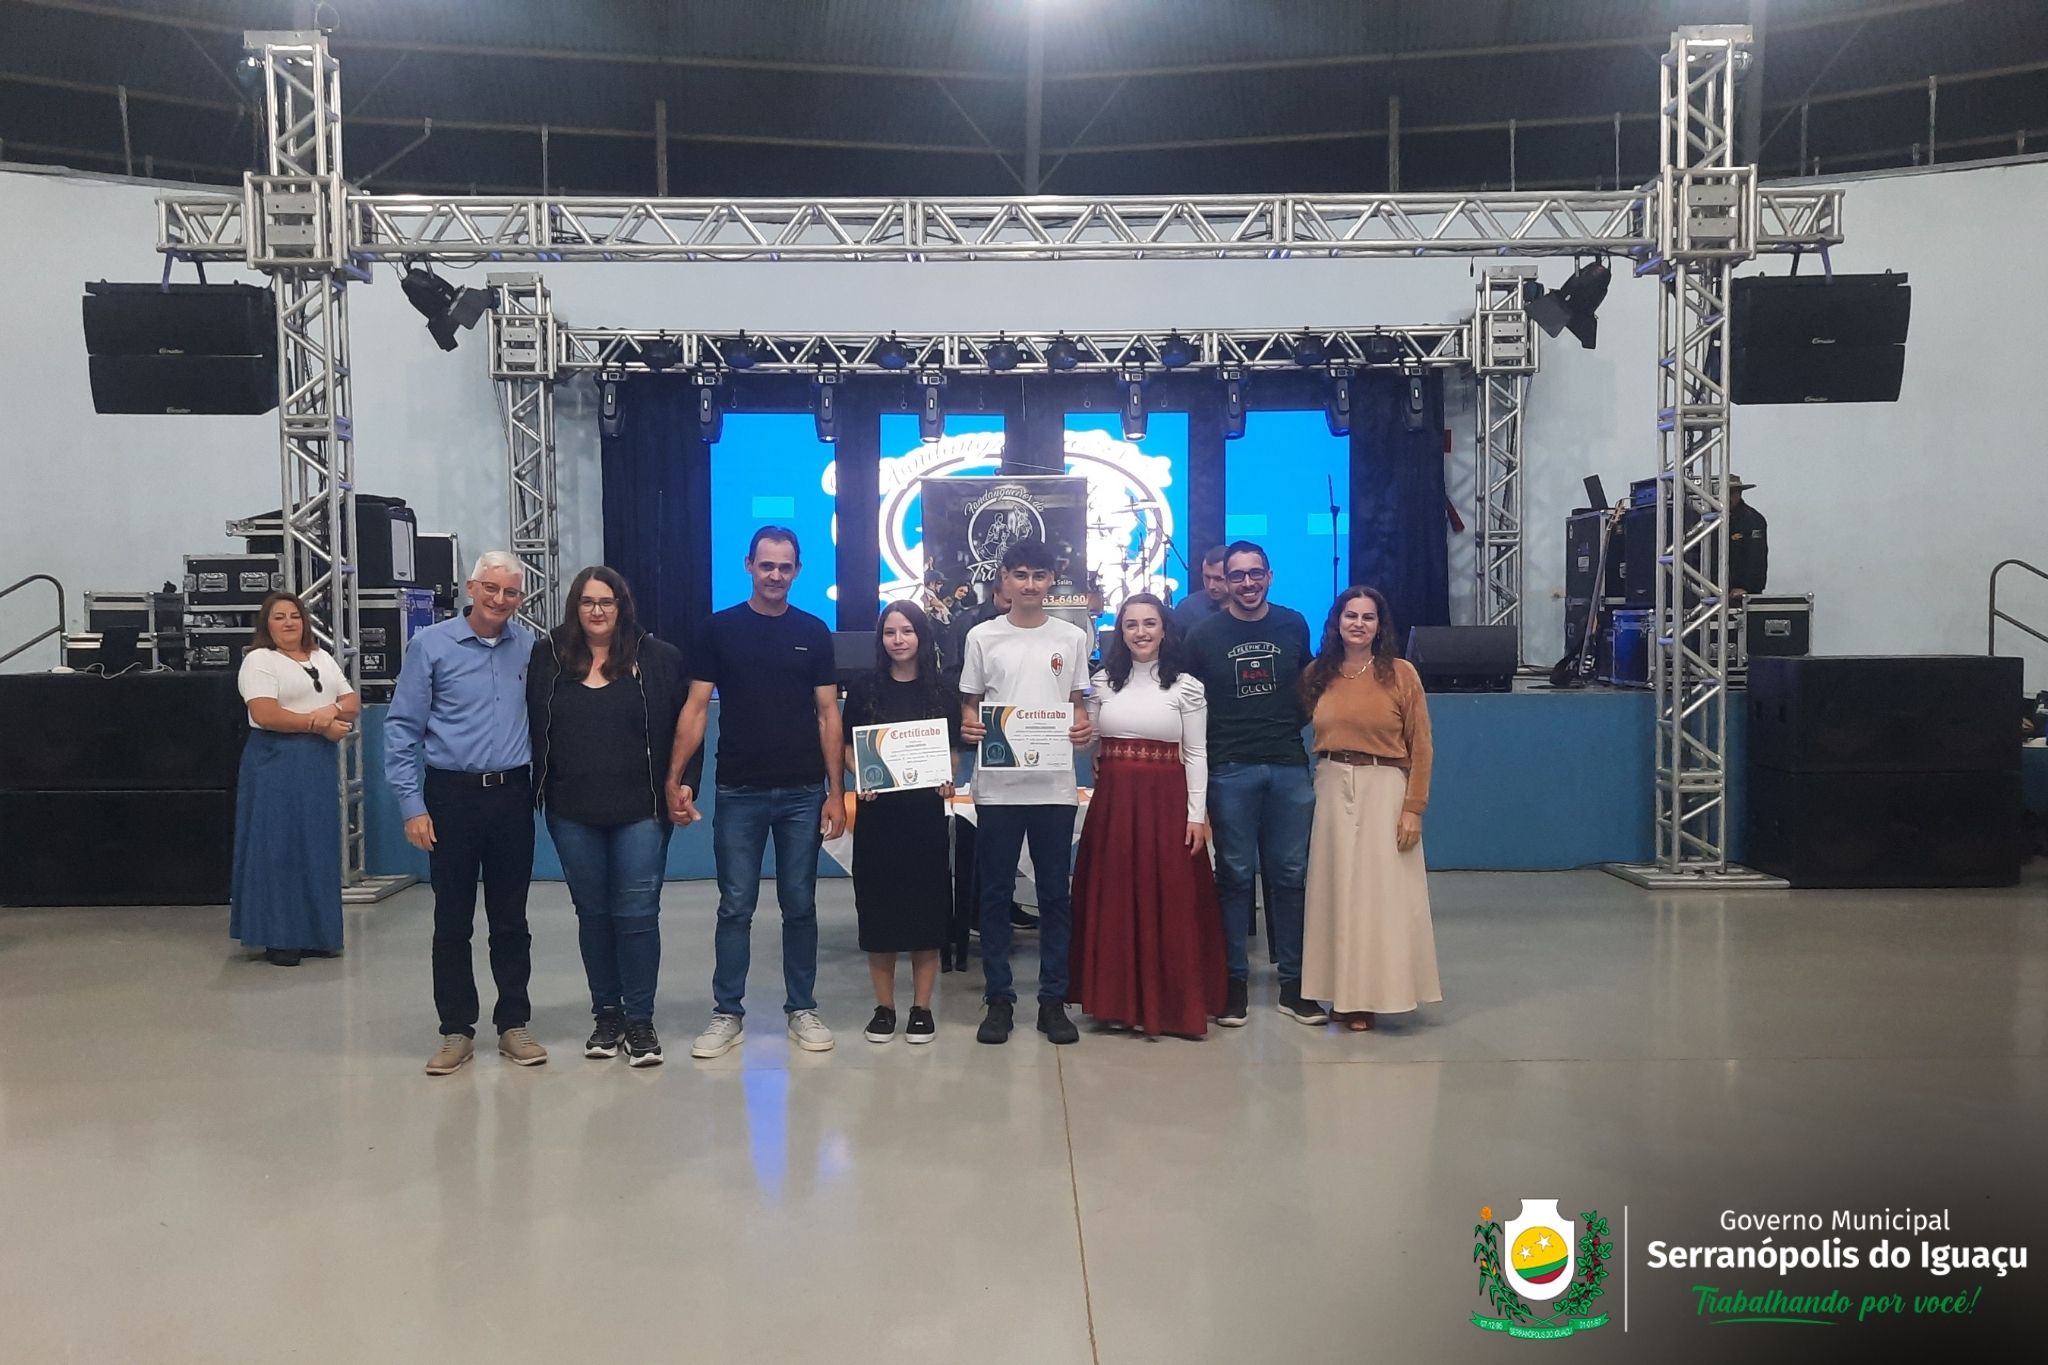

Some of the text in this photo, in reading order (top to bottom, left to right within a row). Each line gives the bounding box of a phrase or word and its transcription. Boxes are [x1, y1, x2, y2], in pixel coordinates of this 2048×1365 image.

[1241, 683, 1272, 694] GUCCI
[1016, 709, 1067, 720] Certificado
[890, 727, 942, 740] Certificado
